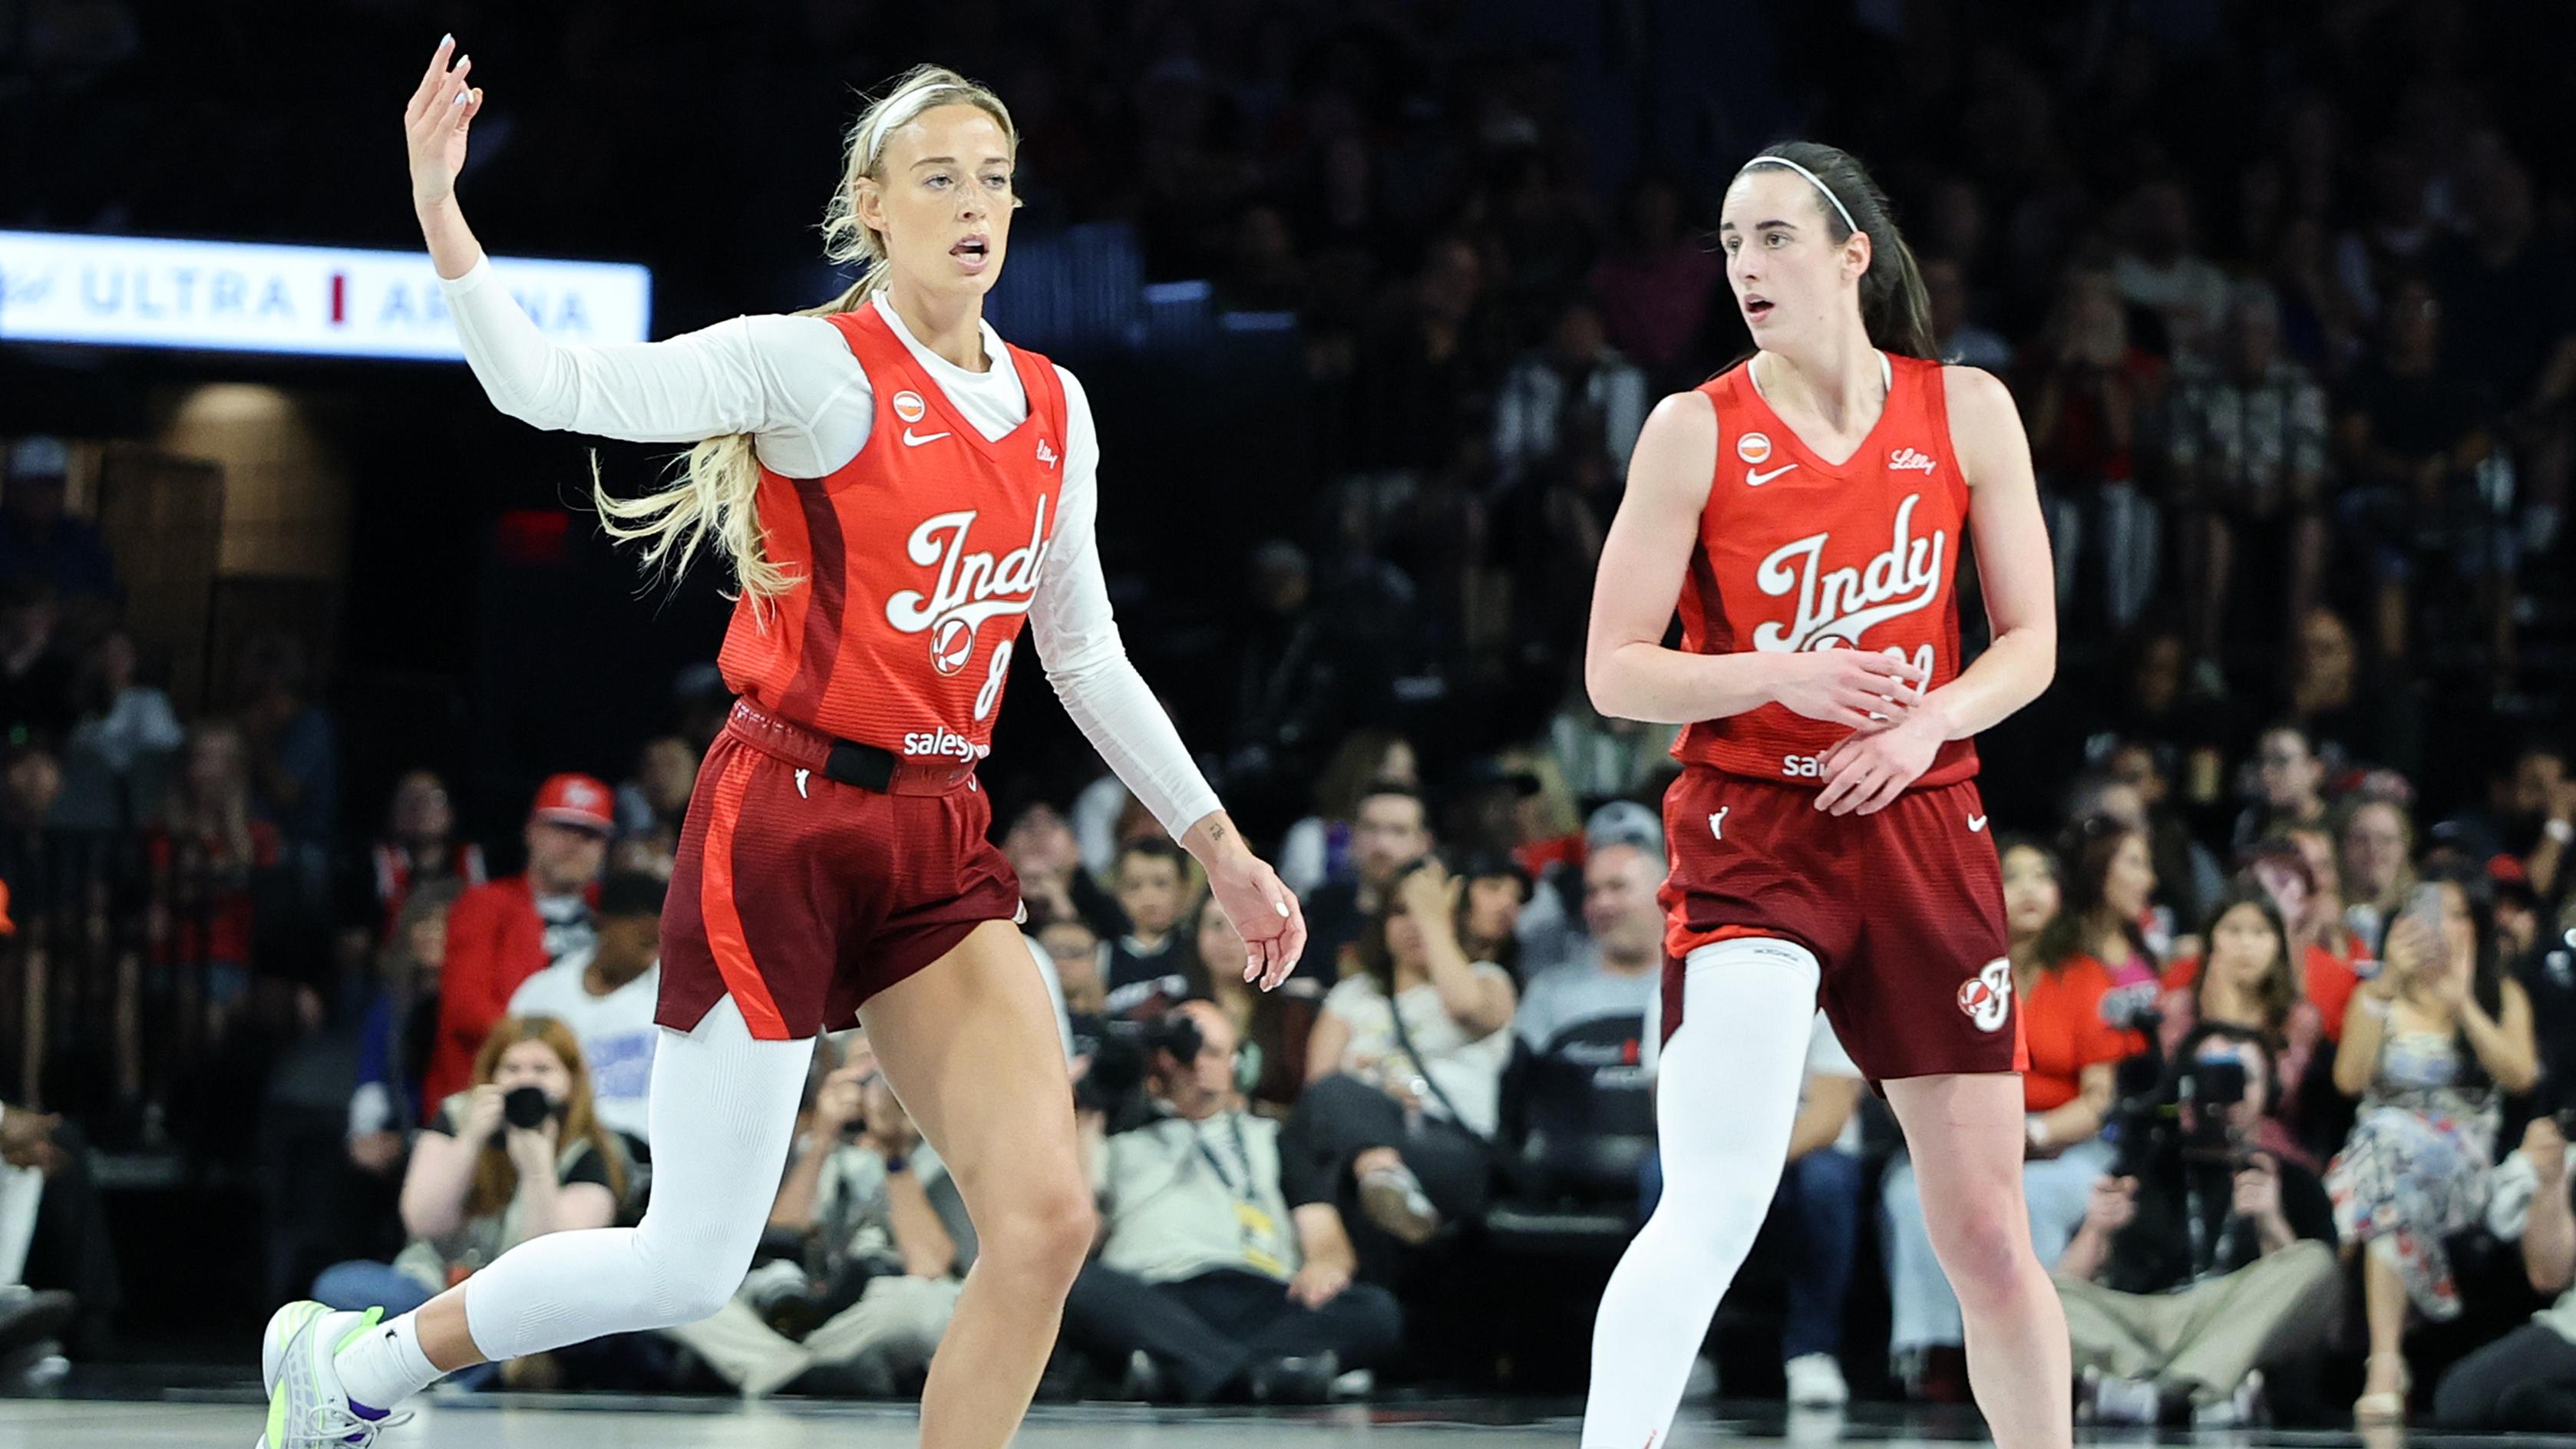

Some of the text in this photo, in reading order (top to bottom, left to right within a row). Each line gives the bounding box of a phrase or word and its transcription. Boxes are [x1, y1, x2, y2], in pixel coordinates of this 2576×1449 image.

[79, 262, 298, 324] ULTRA
[373, 275, 596, 334] ARNA
[1888, 447, 1937, 476] Lilly
[1752, 493, 1946, 653] Indy
[973, 639, 1014, 721] 8
